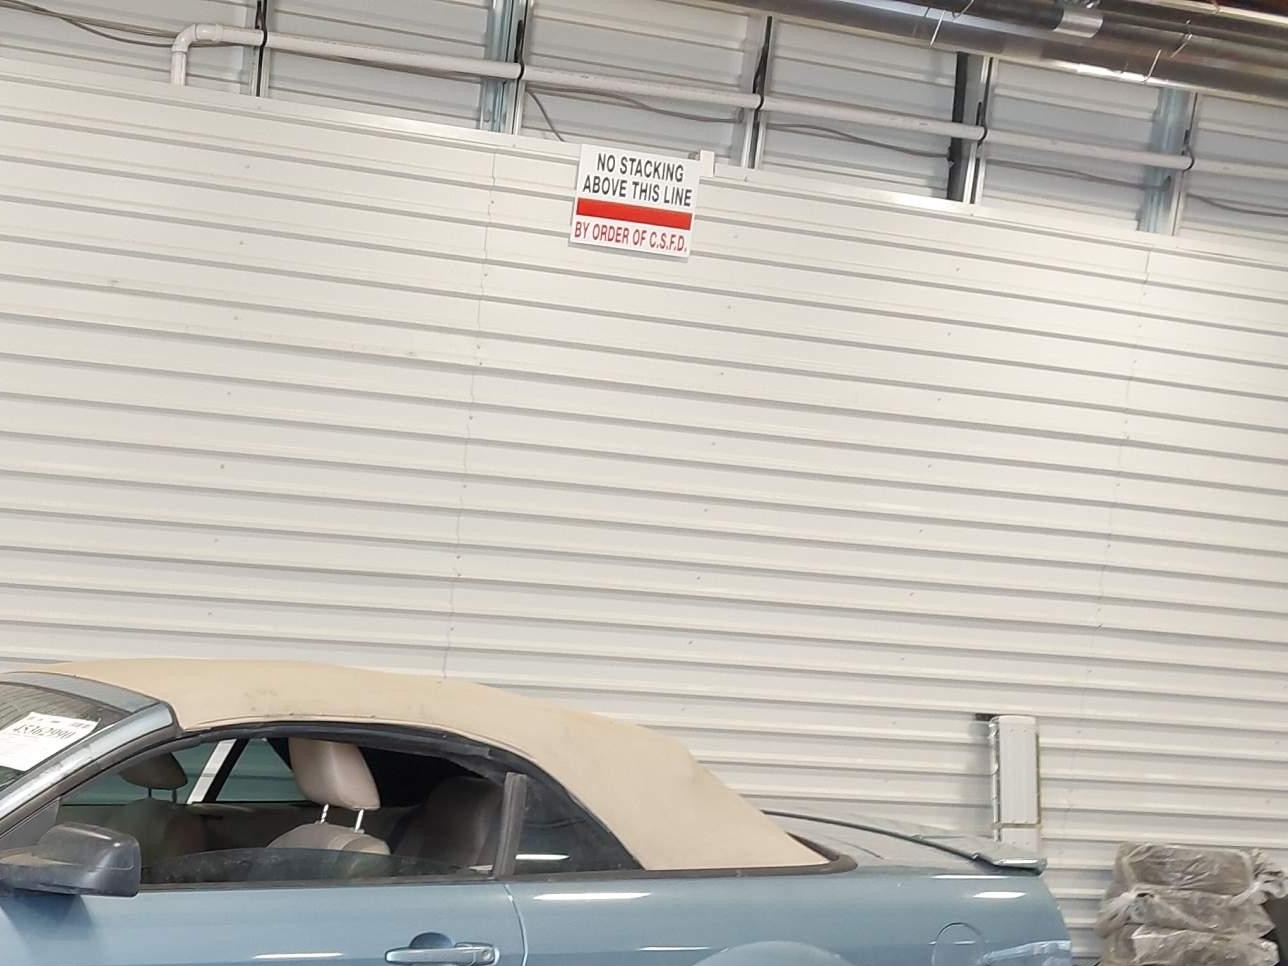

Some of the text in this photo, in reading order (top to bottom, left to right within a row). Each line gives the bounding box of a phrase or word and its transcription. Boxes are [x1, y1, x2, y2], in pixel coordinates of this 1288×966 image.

[596, 153, 684, 182] NO STACKING
[582, 175, 693, 207] ABOVE THIS LINE
[574, 221, 688, 253] BY ORDER OF C.S.F.D.
